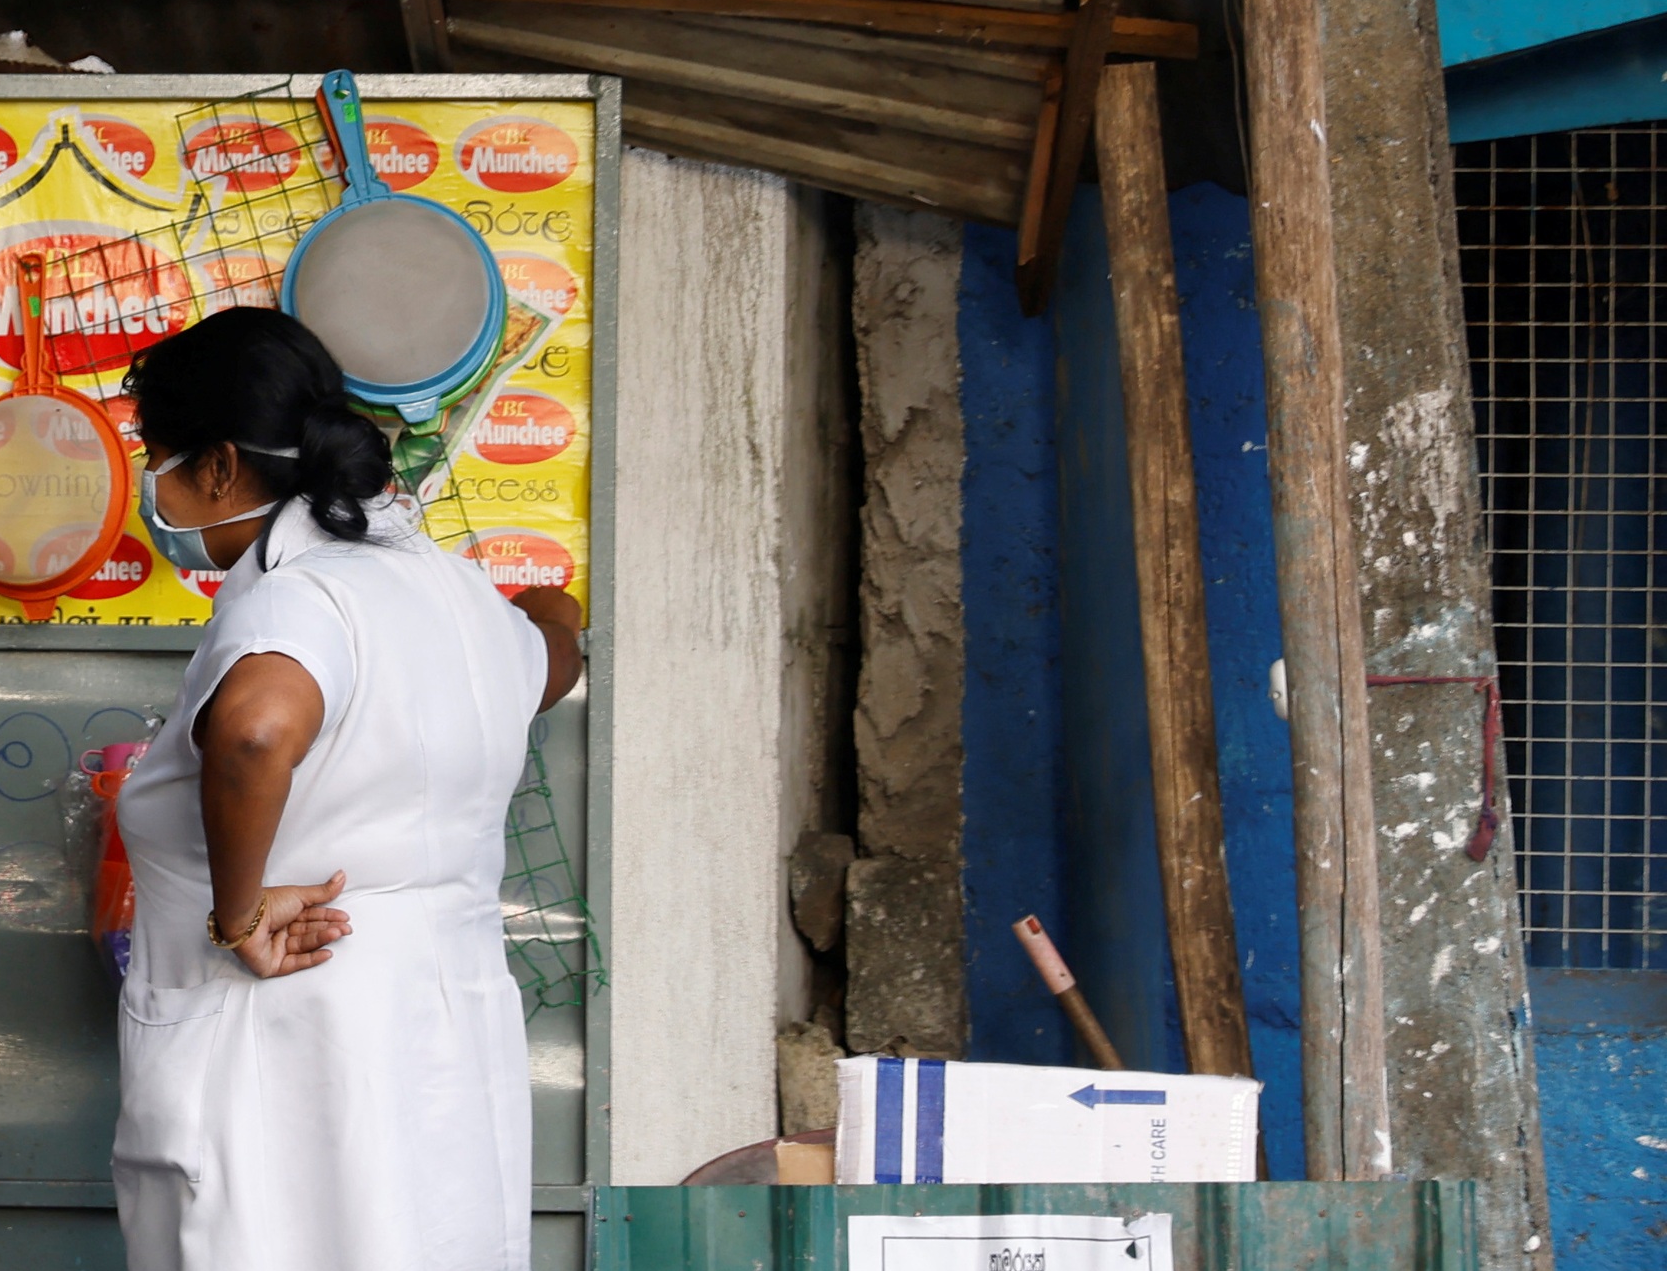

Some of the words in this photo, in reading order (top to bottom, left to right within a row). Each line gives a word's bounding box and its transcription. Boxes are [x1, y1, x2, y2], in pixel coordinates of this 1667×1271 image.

[214, 127, 253, 145] CBL
[491, 127, 531, 145] CBL
[194, 145, 291, 175] Munchee
[373, 146, 429, 174] nchee
[471, 146, 567, 175] Munchee
[490, 400, 530, 417] CBL
[488, 540, 527, 558] CBL
[1151, 1118, 1166, 1160] CARE
